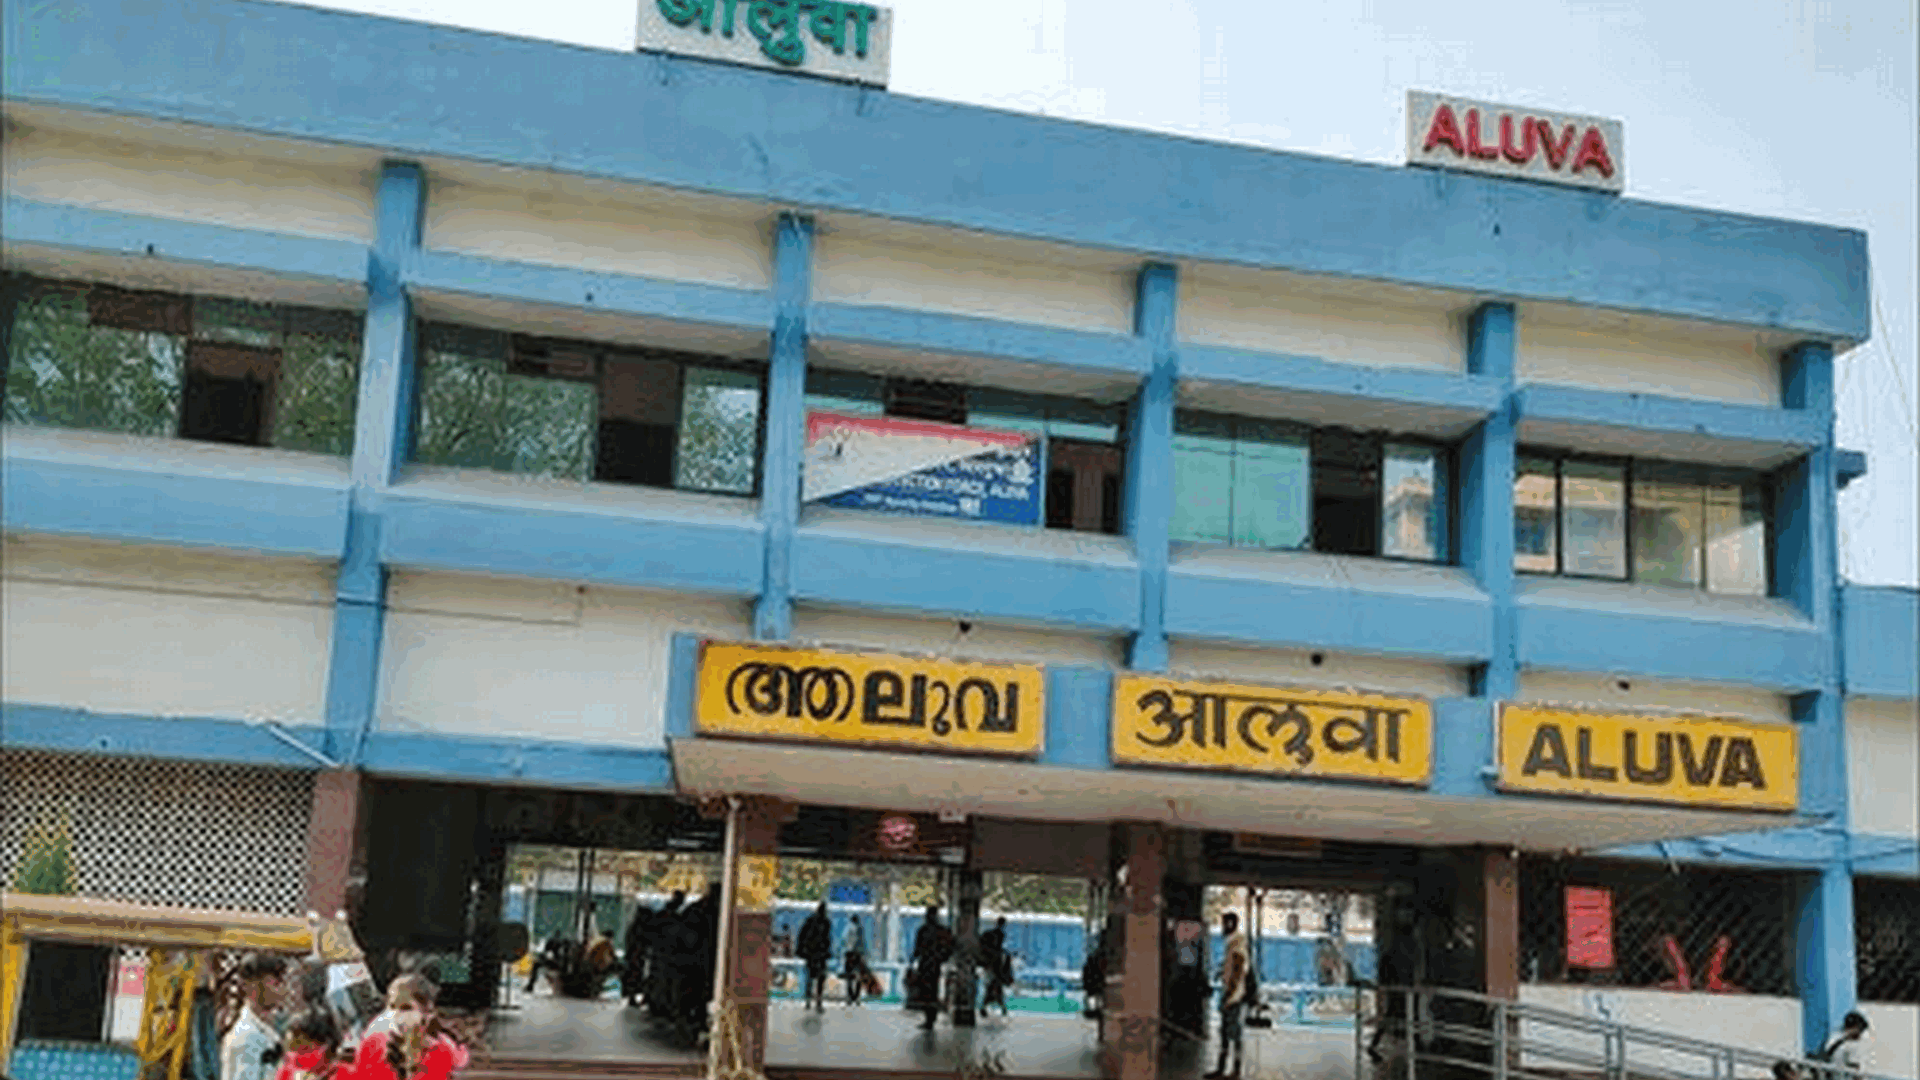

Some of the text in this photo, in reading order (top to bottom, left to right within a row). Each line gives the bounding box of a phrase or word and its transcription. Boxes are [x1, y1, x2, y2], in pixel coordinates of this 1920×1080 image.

[1422, 104, 1615, 178] ALUVA
[725, 661, 1019, 736] ആലുവ
[1136, 689, 1412, 765] आलुवा
[1521, 722, 1768, 790] ALUVA
